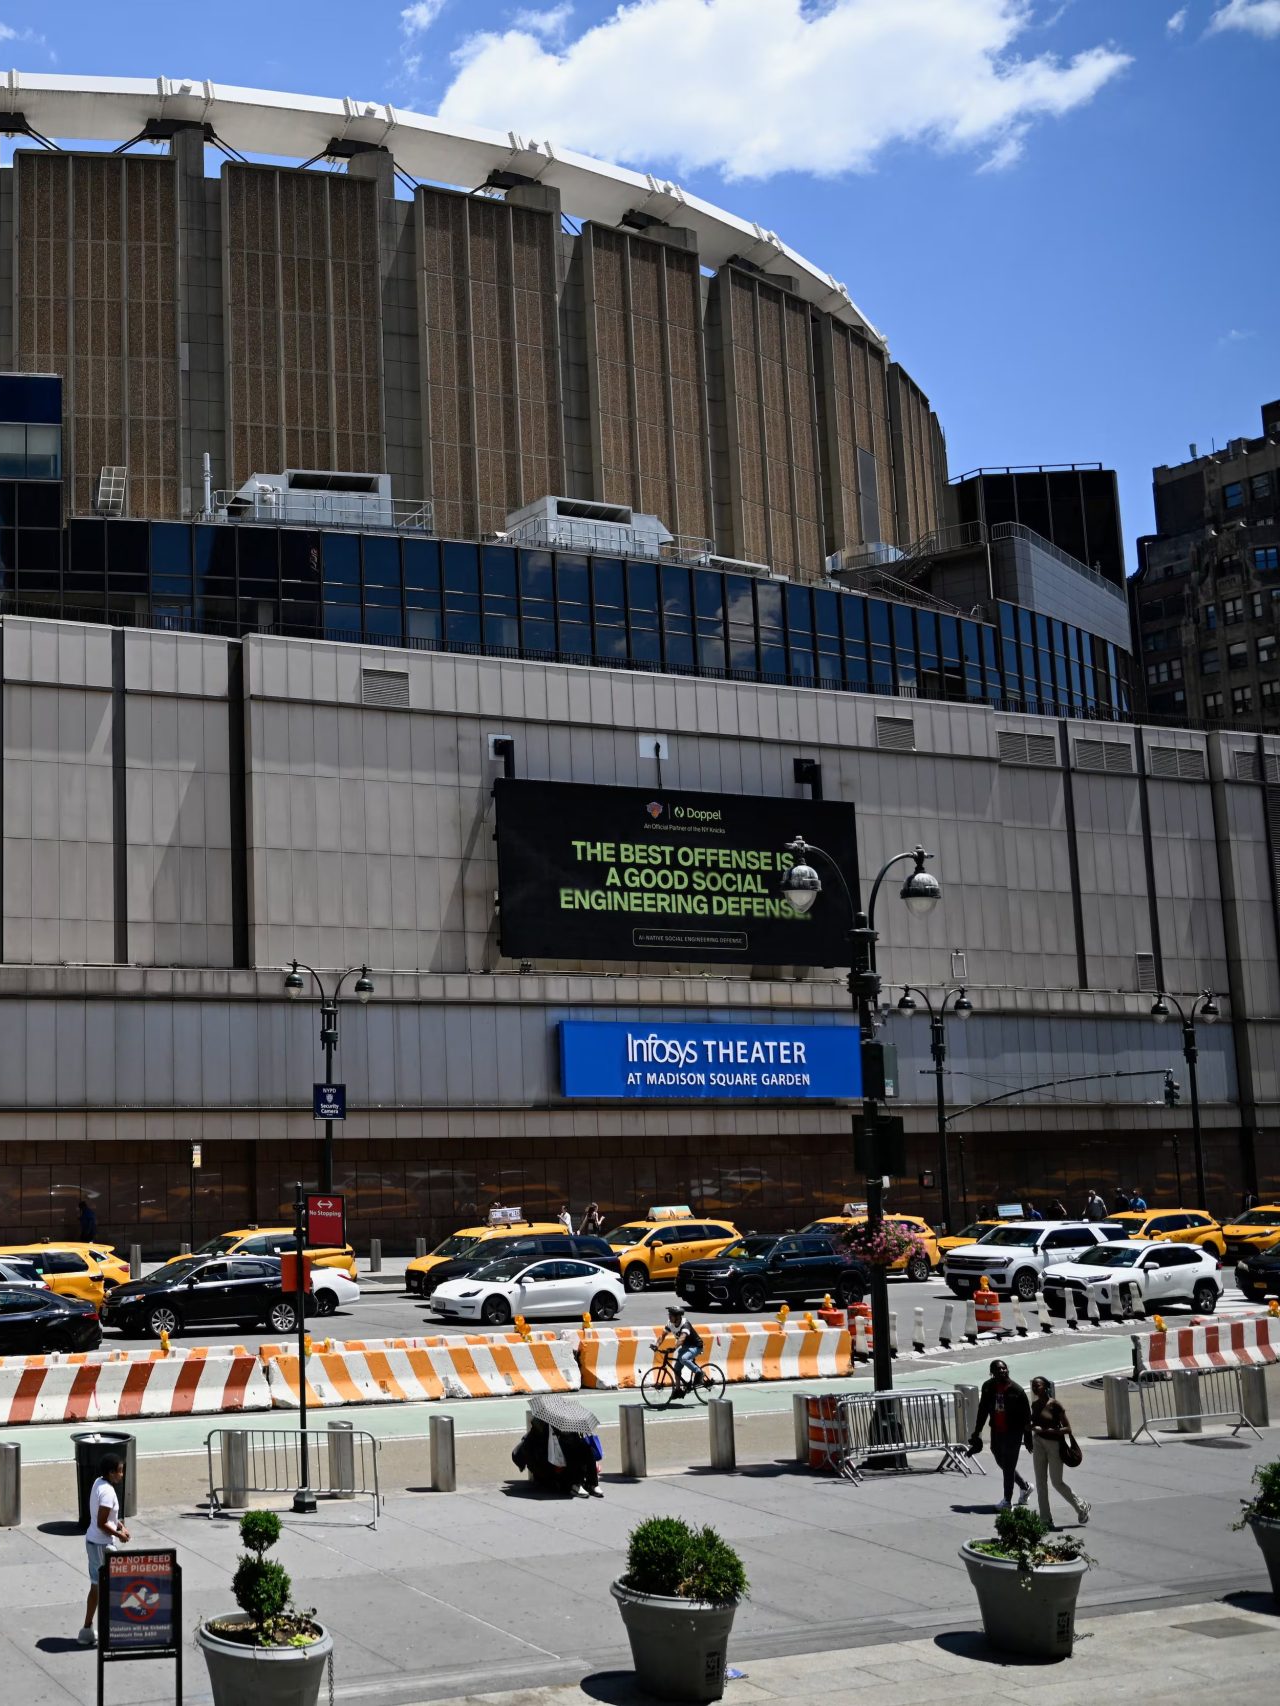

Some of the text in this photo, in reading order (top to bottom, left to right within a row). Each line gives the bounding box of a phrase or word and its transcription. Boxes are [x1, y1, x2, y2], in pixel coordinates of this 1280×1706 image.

[686, 807, 722, 822] Doppel
[571, 840, 795, 872] THE BEST OFFENSE IS
[605, 866, 769, 894] A GOOD SOCIAL
[559, 887, 709, 915] ENGINEERING
[627, 1032, 807, 1068] Infosys THEATER
[627, 1072, 810, 1087] AT MADISON SQUARE GARDEN
[317, 1210, 342, 1218] Stopping
[110, 1554, 171, 1565] DO NOT FEED
[110, 1563, 171, 1573] THE PIGEONS
